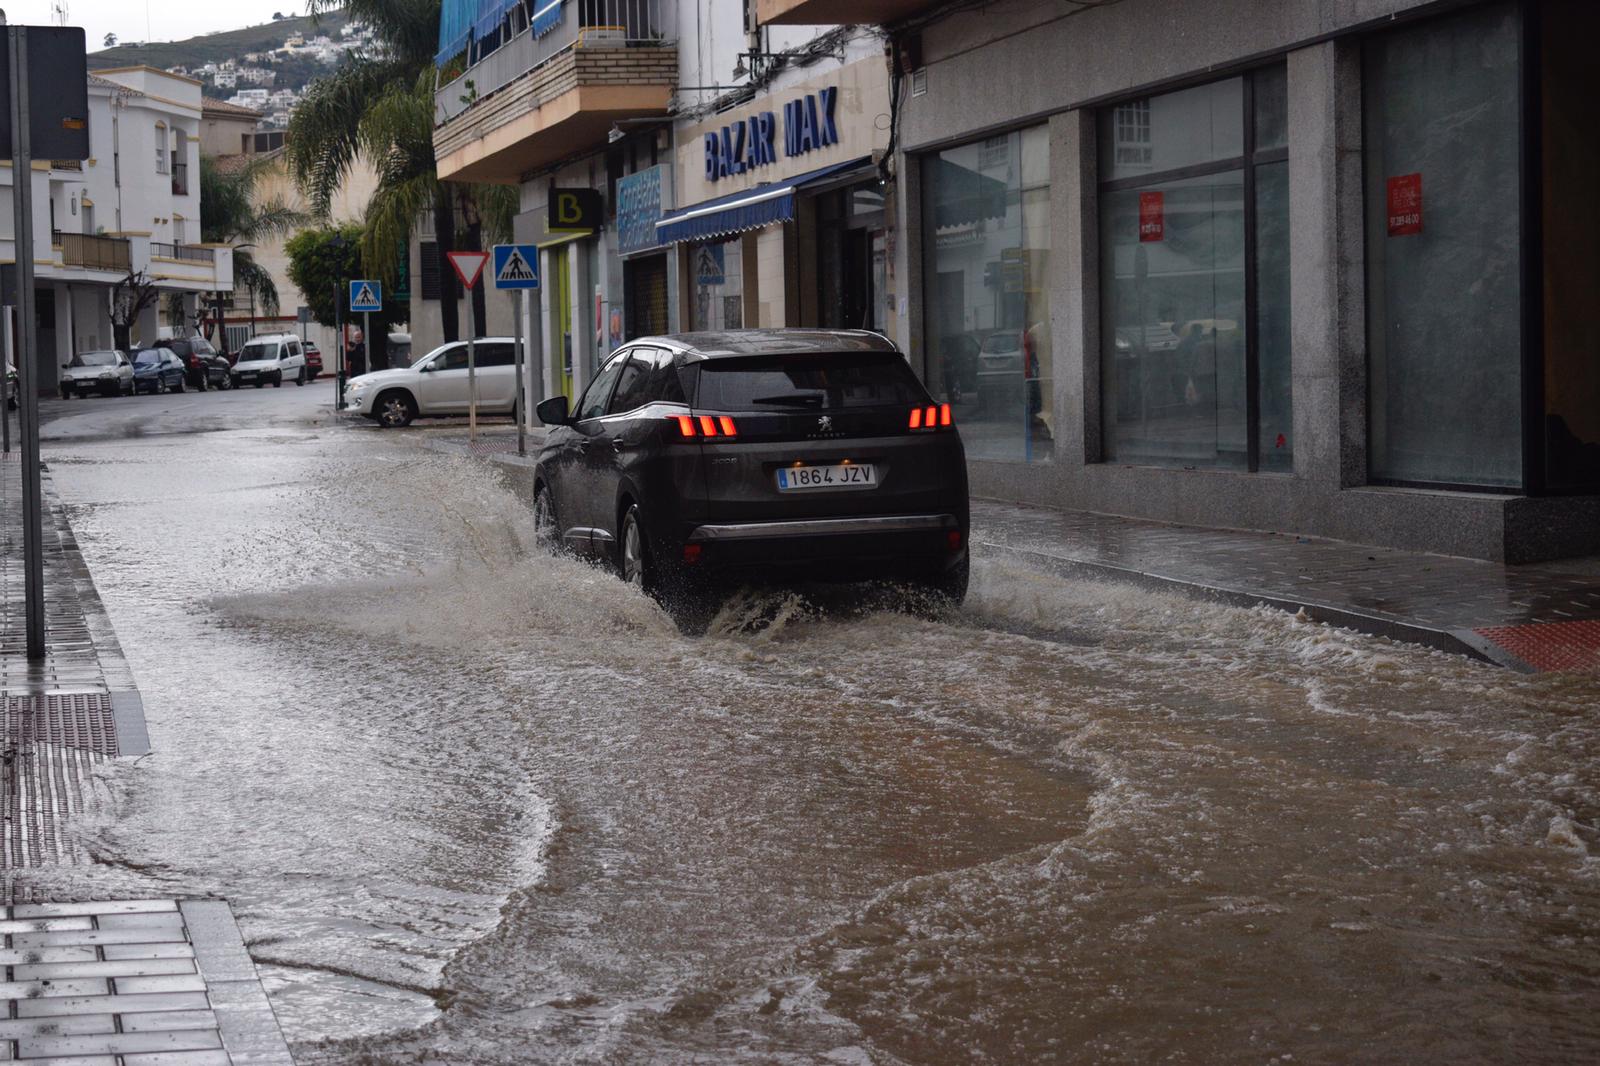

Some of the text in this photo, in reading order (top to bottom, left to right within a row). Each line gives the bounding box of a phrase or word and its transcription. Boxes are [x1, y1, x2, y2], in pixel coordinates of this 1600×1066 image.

[704, 86, 839, 182] BAZAR MAX
[558, 193, 582, 223] B
[790, 466, 871, 486] 1864 JZV
